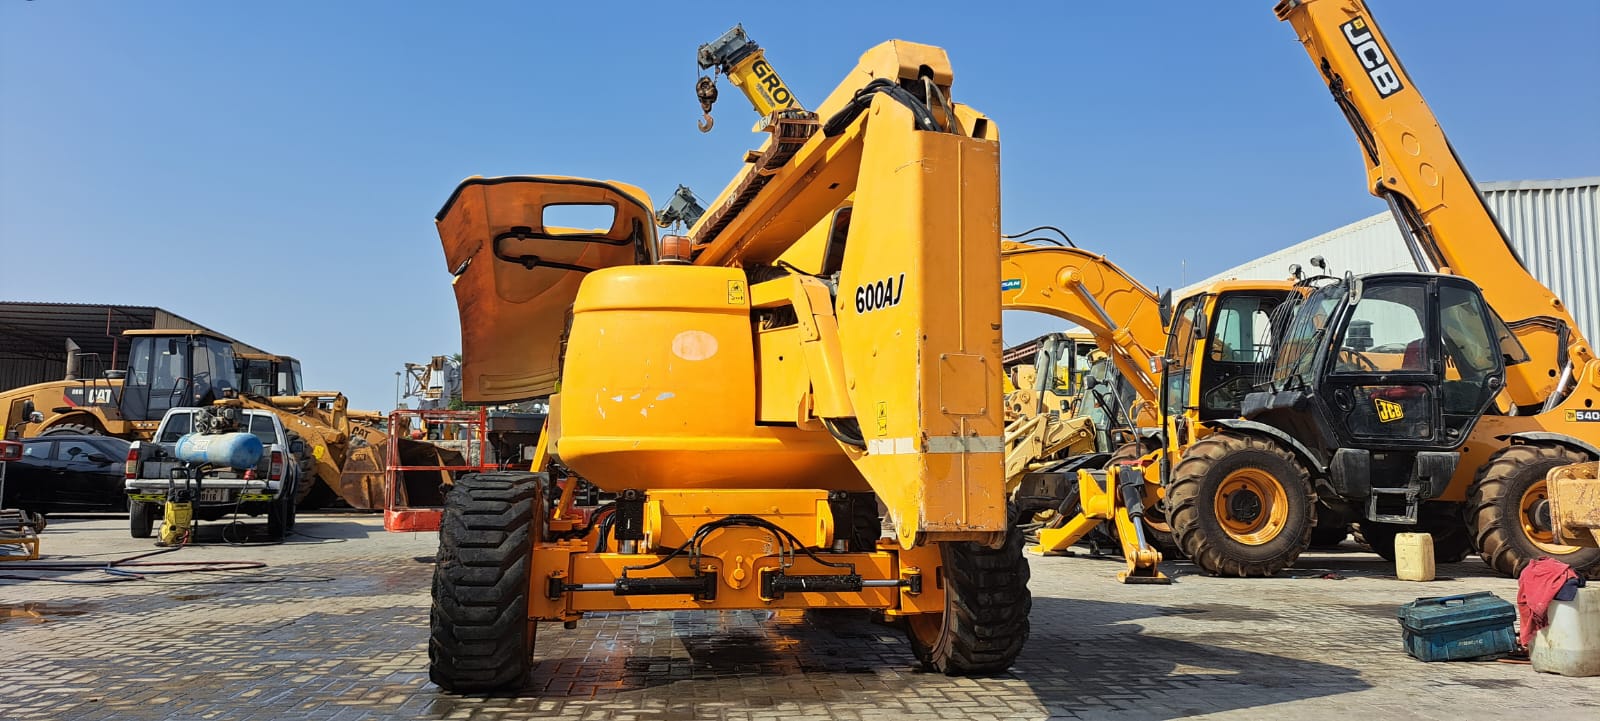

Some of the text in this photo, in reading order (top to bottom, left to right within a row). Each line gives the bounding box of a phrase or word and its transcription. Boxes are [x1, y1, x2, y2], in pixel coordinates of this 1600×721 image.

[1343, 22, 1400, 95] JCB
[855, 273, 905, 314] 600AJ
[88, 388, 112, 404] CAT
[1379, 401, 1402, 420] JCB
[351, 426, 371, 440] CAT
